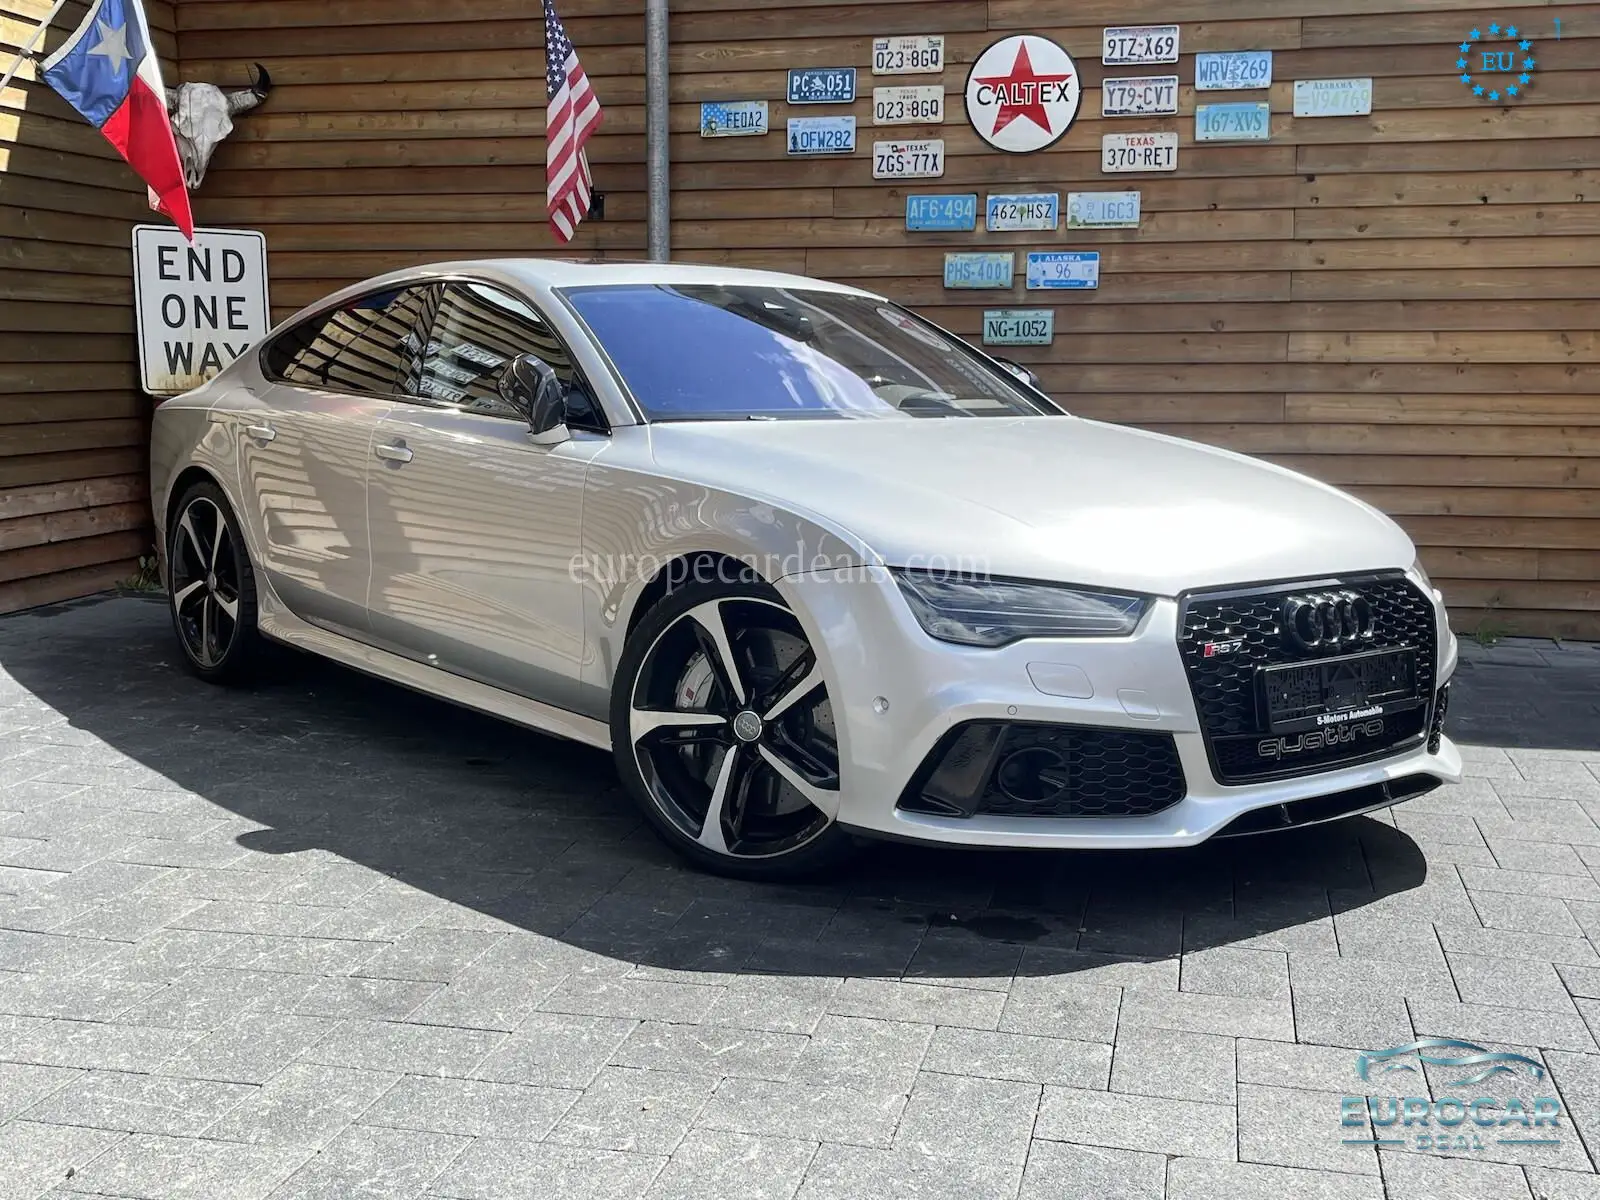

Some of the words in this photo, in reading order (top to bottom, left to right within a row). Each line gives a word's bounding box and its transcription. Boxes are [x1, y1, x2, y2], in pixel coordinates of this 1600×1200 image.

[976, 82, 1070, 106] CALTEX
[1313, 81, 1353, 89] ALABAMA
[906, 144, 928, 152] TEXAS
[1125, 136, 1155, 146] TEXAS
[157, 245, 245, 283] END
[1055, 263, 1071, 279] 96
[161, 293, 249, 330] ONE
[988, 320, 1047, 337] NG-1052
[1316, 711, 1348, 726] S-Motors
[1349, 705, 1383, 719] Automobile
[1257, 718, 1384, 761] quattro
